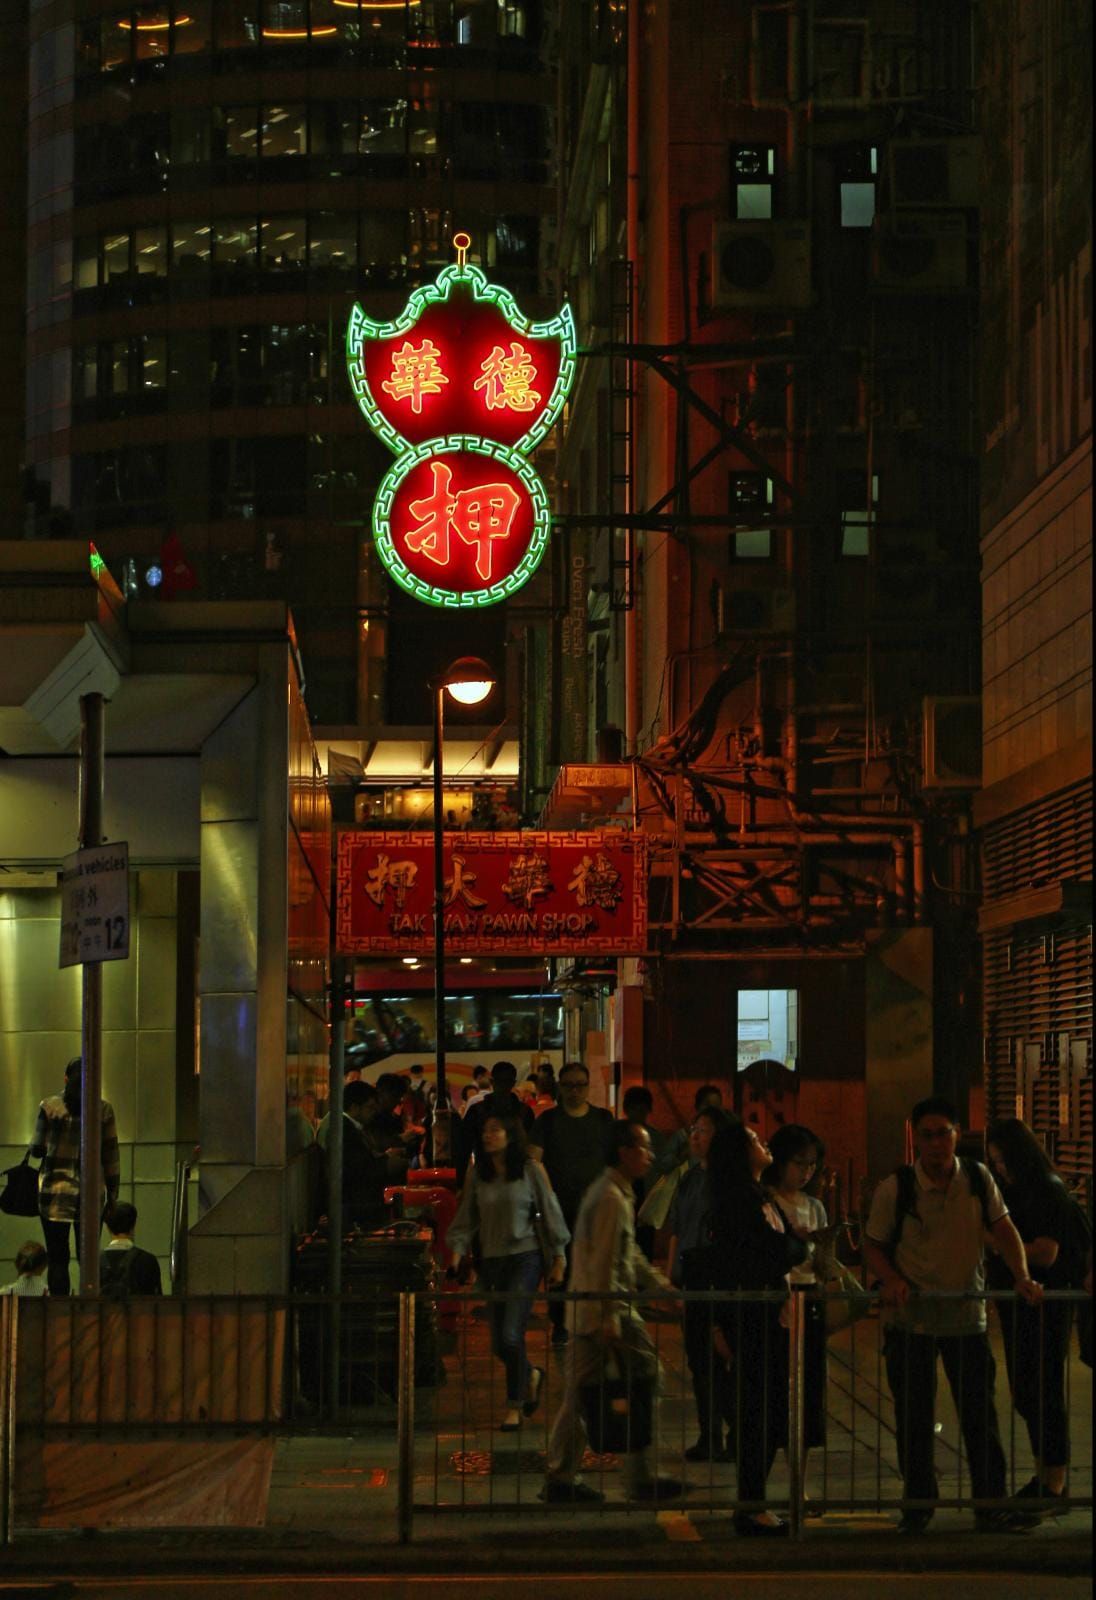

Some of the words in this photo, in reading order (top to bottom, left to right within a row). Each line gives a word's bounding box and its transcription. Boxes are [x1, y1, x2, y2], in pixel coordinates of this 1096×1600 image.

[404, 461, 521, 581] 押
[100, 915, 125, 951] 12
[389, 913, 427, 932] TAK
[482, 913, 537, 932] PAWN
[542, 913, 594, 933] SHOP
